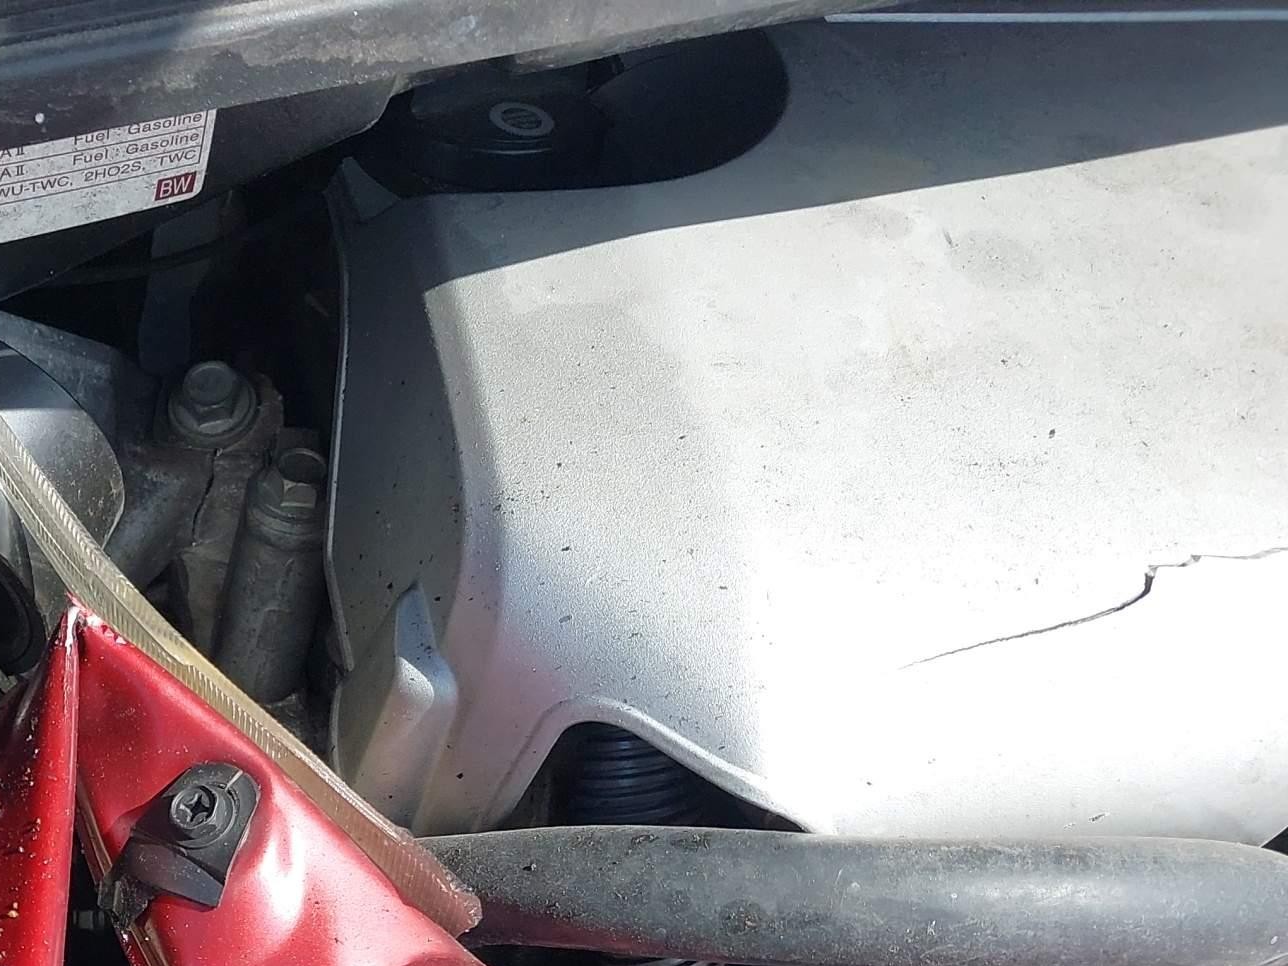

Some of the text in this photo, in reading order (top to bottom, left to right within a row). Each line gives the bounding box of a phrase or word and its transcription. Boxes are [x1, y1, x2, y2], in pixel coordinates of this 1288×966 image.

[73, 127, 110, 146] Fuel
[127, 113, 203, 135] Gasoline
[72, 148, 108, 166] Fuel
[126, 132, 200, 155] Gasoline
[157, 149, 197, 166] TWC
[159, 174, 194, 198] BW
